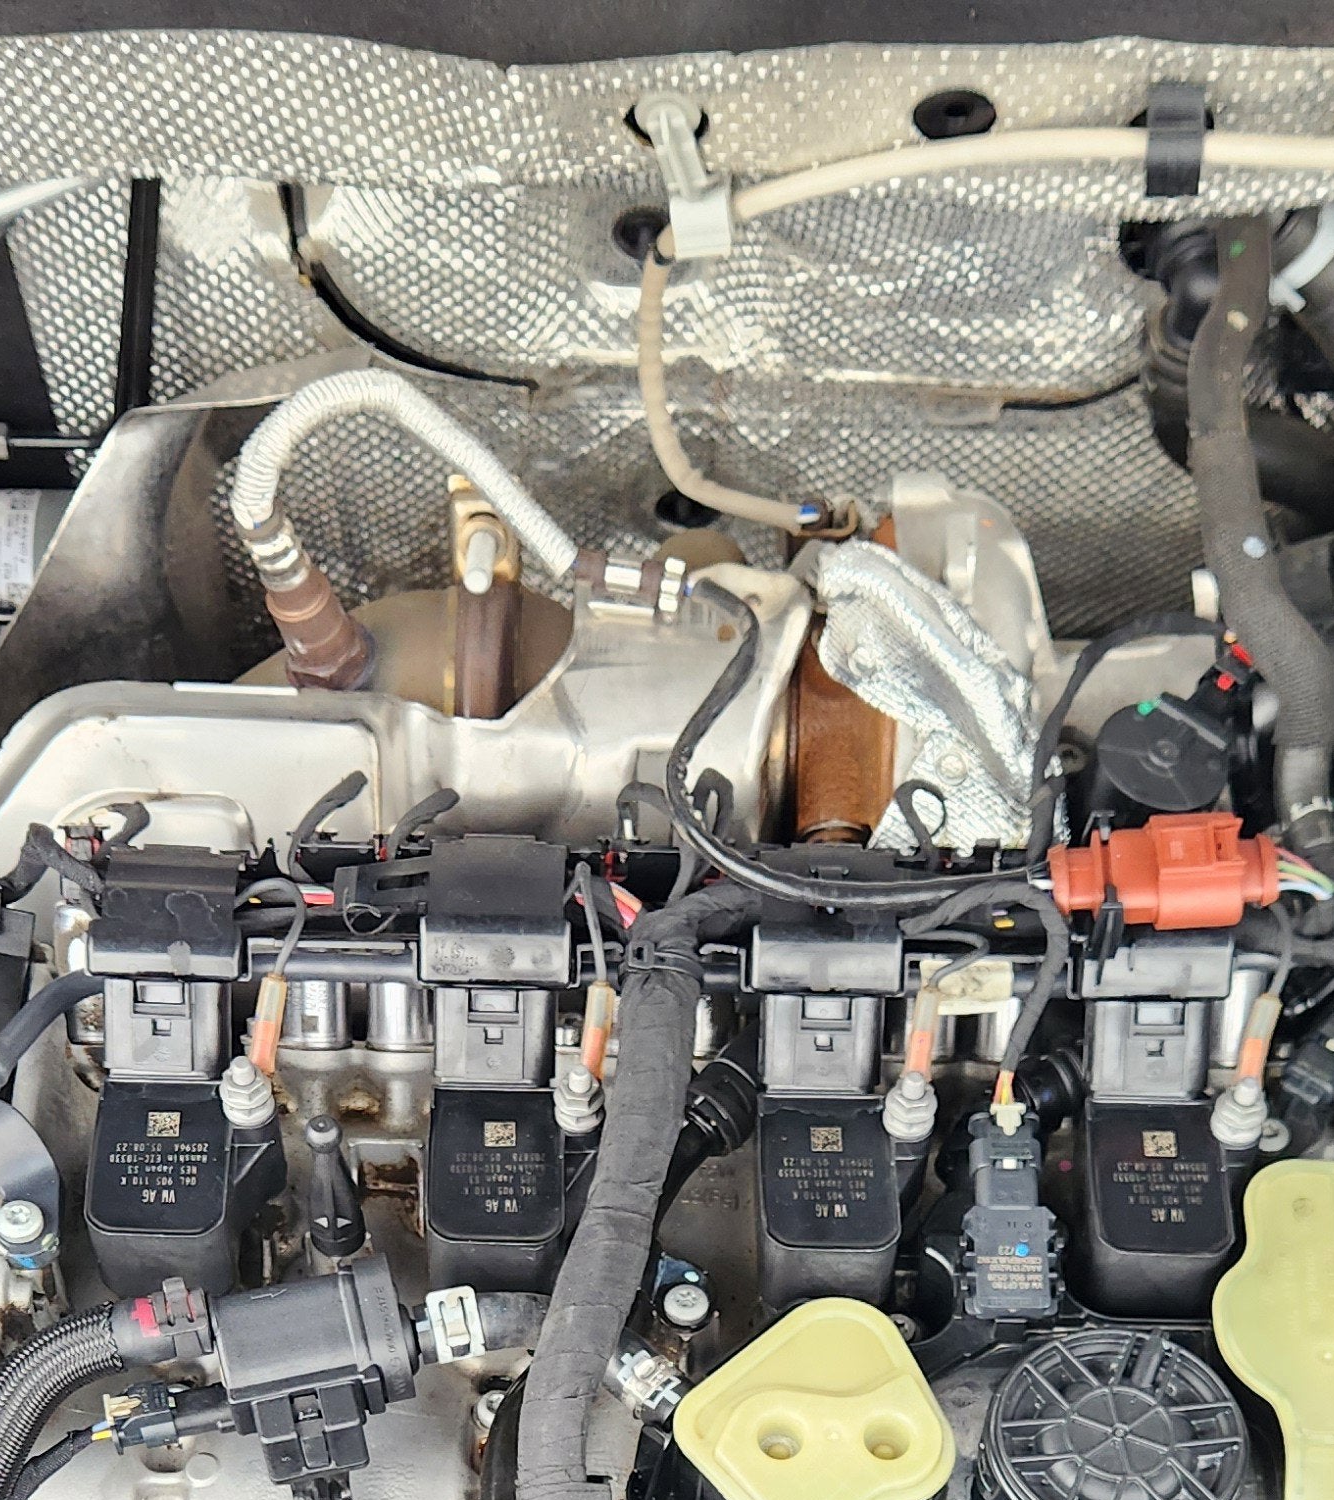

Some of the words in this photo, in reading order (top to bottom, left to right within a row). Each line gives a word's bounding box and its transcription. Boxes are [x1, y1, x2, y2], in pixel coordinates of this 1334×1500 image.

[145, 1165, 173, 1173] Japan
[132, 1177, 148, 1185] 110
[155, 1177, 173, 1185] 905
[141, 1190, 156, 1203] AG
[161, 1190, 175, 1203] VW
[485, 1199, 499, 1211] AG
[505, 1199, 518, 1212] VW
[815, 1204, 828, 1217] AG
[834, 1204, 848, 1217] VW
[1151, 1209, 1165, 1221] AG
[1171, 1209, 1185, 1221] VW
